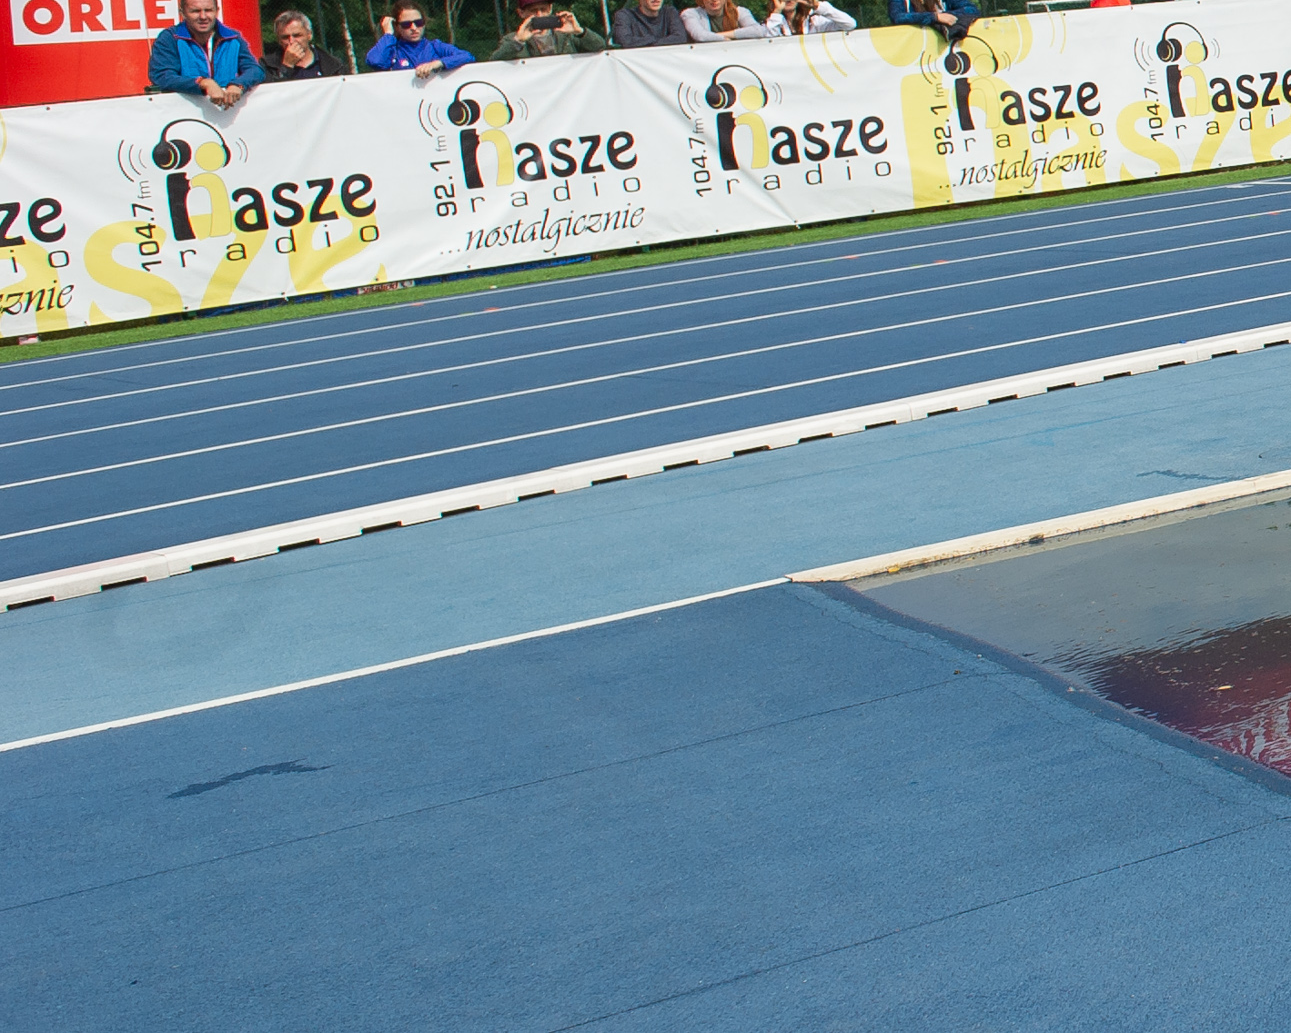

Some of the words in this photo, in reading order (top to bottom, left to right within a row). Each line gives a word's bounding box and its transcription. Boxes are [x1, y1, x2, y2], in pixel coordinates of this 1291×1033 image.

[934, 81, 945, 98] fm
[1147, 69, 1157, 85] fm
[692, 117, 704, 135] fm
[953, 77, 1101, 131] nasze
[1144, 86, 1165, 142] 104.7
[435, 134, 448, 153] fm
[715, 111, 889, 171] nasze
[930, 104, 955, 156] 92.1
[962, 122, 1105, 153] radio
[459, 127, 639, 190] nasze
[688, 137, 714, 197] 104.7
[725, 160, 892, 195] radio
[138, 180, 152, 200] fm
[166, 171, 377, 242] nasze
[430, 159, 458, 218] 92.1
[470, 176, 642, 213] radio
[132, 202, 162, 272] 104.7
[179, 223, 380, 268] radio
